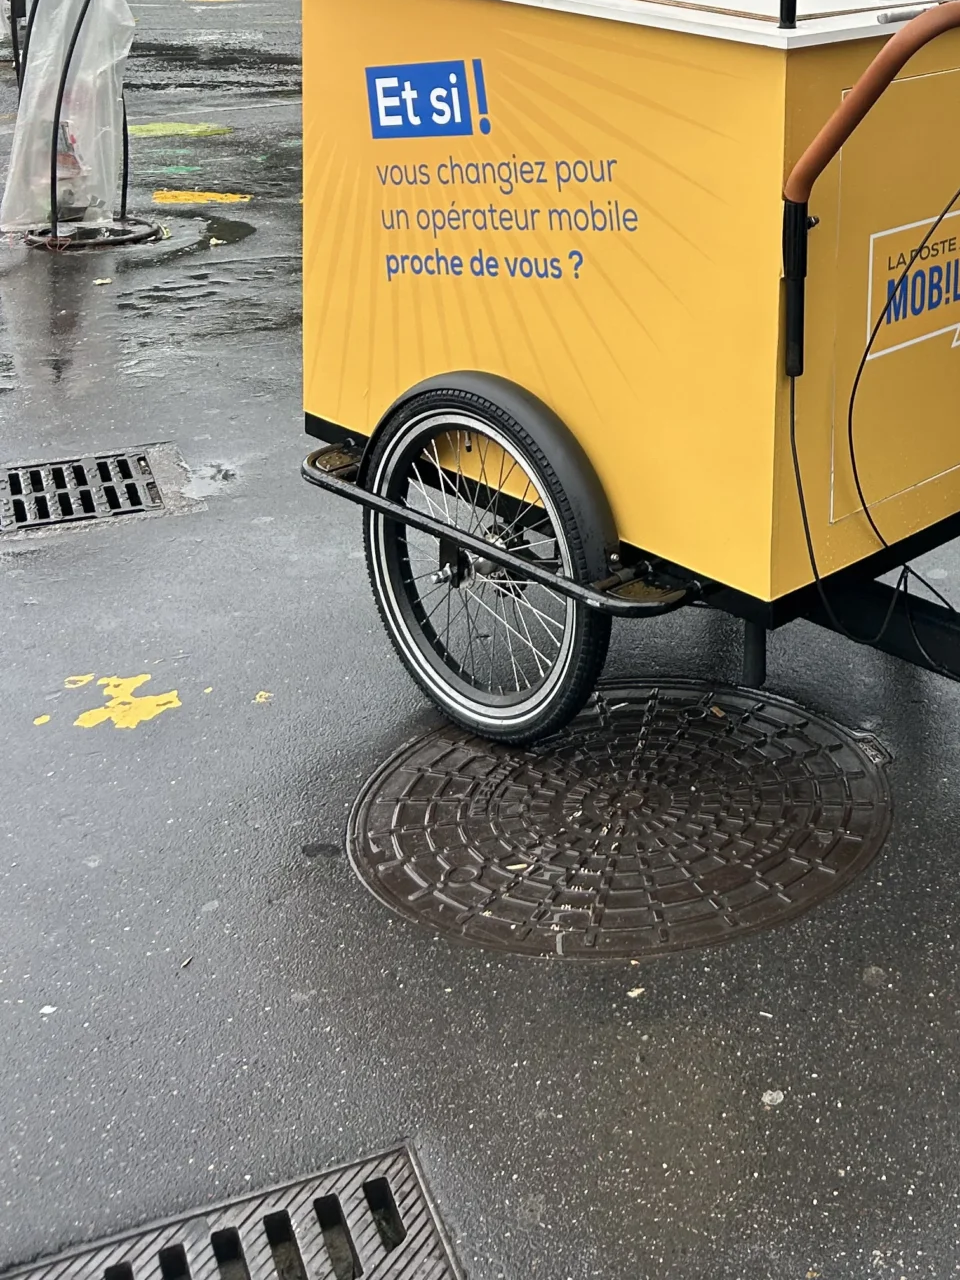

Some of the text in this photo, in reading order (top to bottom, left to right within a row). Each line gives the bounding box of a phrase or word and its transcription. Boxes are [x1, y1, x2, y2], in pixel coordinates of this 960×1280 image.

[375, 76, 421, 126] Et
[376, 153, 618, 195] vous changiez pour
[381, 200, 639, 239] un opérateur mobile
[385, 247, 463, 282] proche
[470, 248, 499, 277] de
[504, 256, 563, 279] vous
[887, 236, 957, 271] LA POSTE
